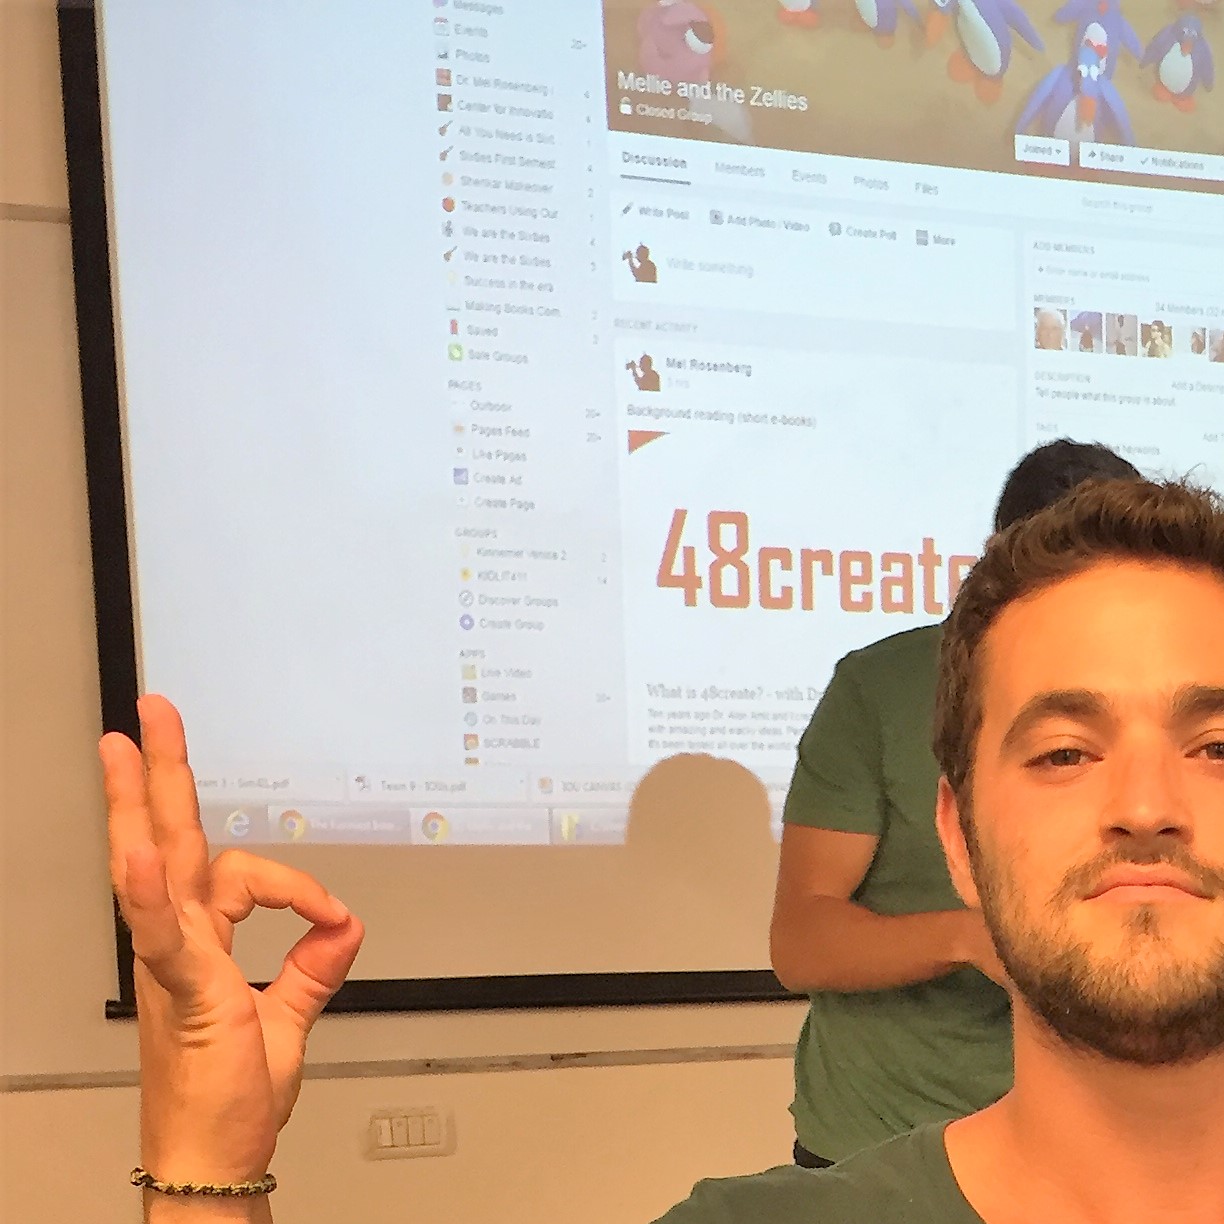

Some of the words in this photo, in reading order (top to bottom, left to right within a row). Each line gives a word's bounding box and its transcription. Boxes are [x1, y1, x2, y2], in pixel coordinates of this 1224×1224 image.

[454, 23, 489, 38] Events
[455, 49, 490, 63] Photos
[617, 71, 672, 96] Mellie
[677, 80, 711, 101] and
[716, 82, 745, 104] the
[750, 86, 809, 111] Zellies
[636, 103, 675, 119] Closed
[677, 108, 713, 125] Group
[621, 151, 687, 169] Discussion
[1100, 151, 1124, 163] Share
[1152, 157, 1204, 171] Notifications
[715, 161, 766, 178] Members
[792, 169, 827, 185] Events
[853, 175, 889, 190] Photos
[915, 182, 938, 195] Files
[461, 200, 506, 215] Teachers
[508, 204, 538, 219] Using
[639, 206, 664, 218] Write
[666, 207, 690, 220] Post
[727, 213, 747, 226] Add
[748, 215, 777, 229] Photo
[783, 219, 811, 232] Video
[846, 226, 877, 238] Create
[933, 234, 956, 246] More
[1054, 243, 1095, 255] MEMBERS
[666, 257, 695, 271] Write
[465, 300, 502, 315] Making
[504, 302, 534, 315] Books
[1167, 301, 1204, 315] Members
[466, 324, 499, 337] Saved
[613, 317, 653, 331] RECENT
[655, 320, 698, 333] ACTIVITY
[492, 350, 529, 364] Groups
[666, 357, 687, 369] Mel
[689, 358, 752, 377] Rosenberg
[448, 379, 482, 392] PAGES
[1051, 389, 1079, 400] people
[627, 404, 691, 420] Background
[694, 409, 734, 425] reading
[737, 411, 768, 425] (short
[770, 414, 817, 429] e-books)
[471, 423, 502, 438] Pages
[505, 425, 530, 438] Feed
[495, 449, 527, 463] Pages
[473, 472, 506, 485] Create
[474, 496, 507, 509] Create
[510, 498, 535, 512] Page
[454, 527, 498, 539] GROUPS
[478, 593, 522, 606] Discover
[524, 595, 559, 607] Groups
[479, 617, 512, 630] Create
[514, 618, 546, 632] Group
[459, 649, 486, 659] APPS
[481, 691, 517, 702] Games
[646, 683, 682, 699] What
[775, 686, 803, 701] with
[484, 737, 541, 749] SCRABBLE
[381, 780, 407, 791] Team
